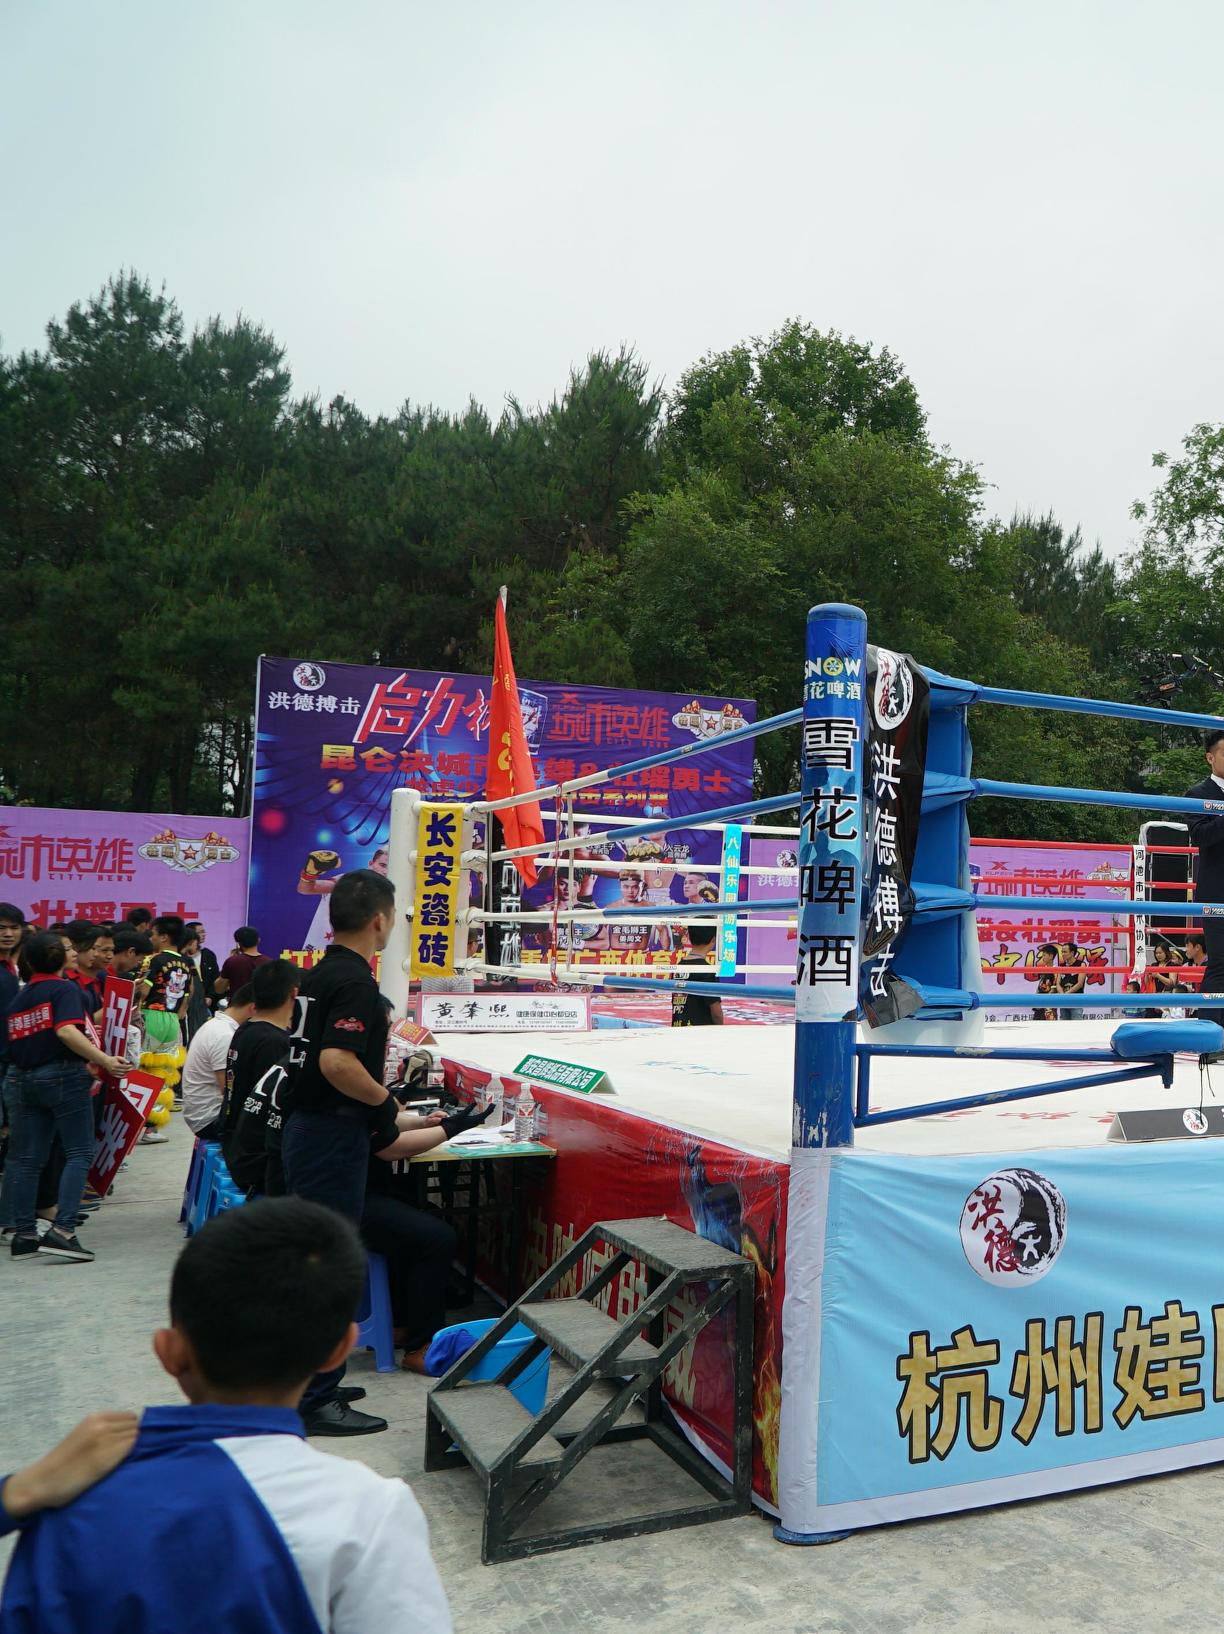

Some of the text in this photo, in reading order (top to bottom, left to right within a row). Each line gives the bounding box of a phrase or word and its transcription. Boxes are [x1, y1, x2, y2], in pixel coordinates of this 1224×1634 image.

[268, 691, 361, 715] 洪德搏击
[804, 680, 861, 700] 花啤酒
[418, 811, 456, 967] 长安瓷砖
[798, 717, 860, 987] 雪花啤酒
[867, 740, 903, 998] 洪德搏击
[1134, 849, 1145, 957] 河池市术协会
